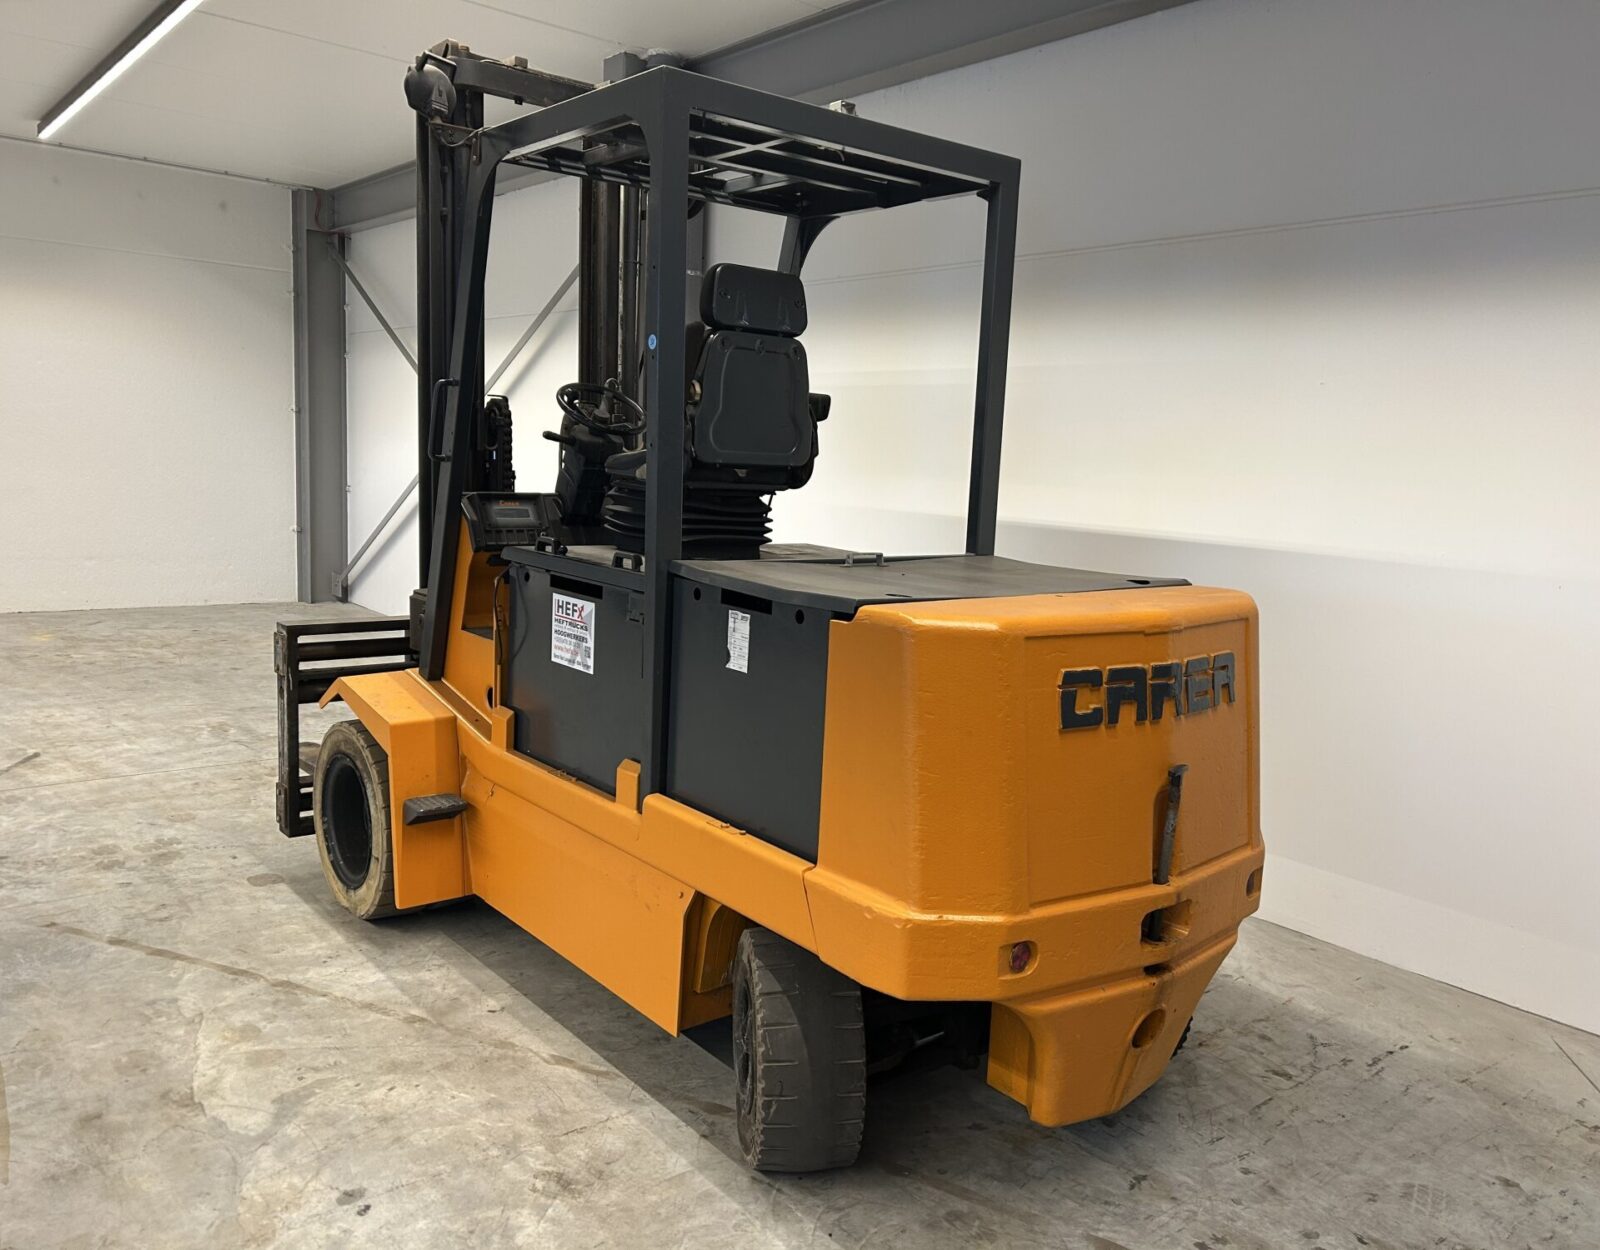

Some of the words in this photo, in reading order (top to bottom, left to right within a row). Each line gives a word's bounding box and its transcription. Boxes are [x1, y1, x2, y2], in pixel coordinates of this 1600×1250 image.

[554, 617, 588, 632] HEFTRUCKS
[554, 629, 588, 644] HOOGWERKERS
[1058, 650, 1236, 730] CARER
